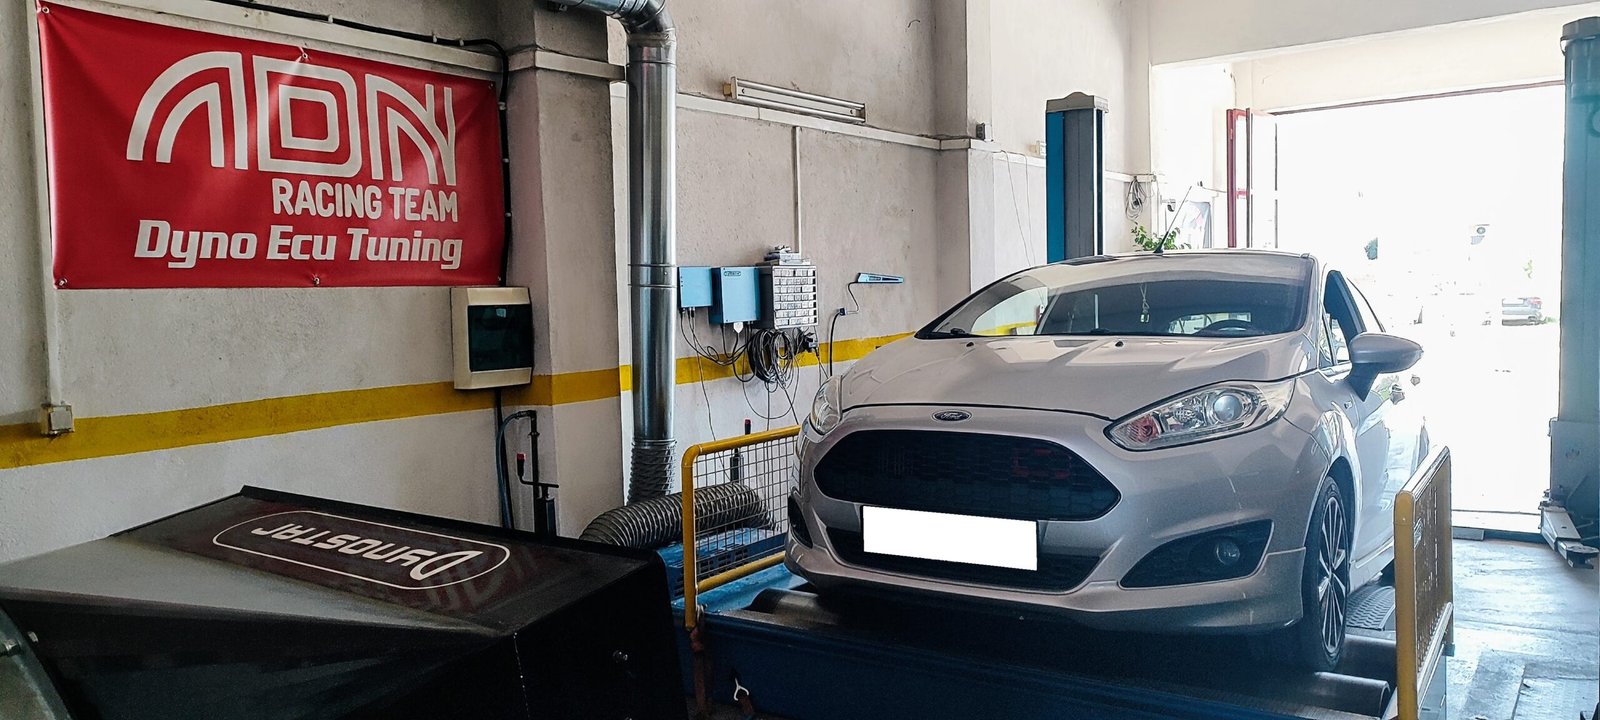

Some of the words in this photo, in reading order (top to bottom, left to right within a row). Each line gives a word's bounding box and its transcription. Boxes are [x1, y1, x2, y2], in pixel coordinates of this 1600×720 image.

[272, 178, 382, 220] RACING
[389, 187, 458, 223] TEAM
[134, 219, 257, 268] Dyno
[266, 225, 337, 261] Ecu
[347, 228, 463, 270] Tuning
